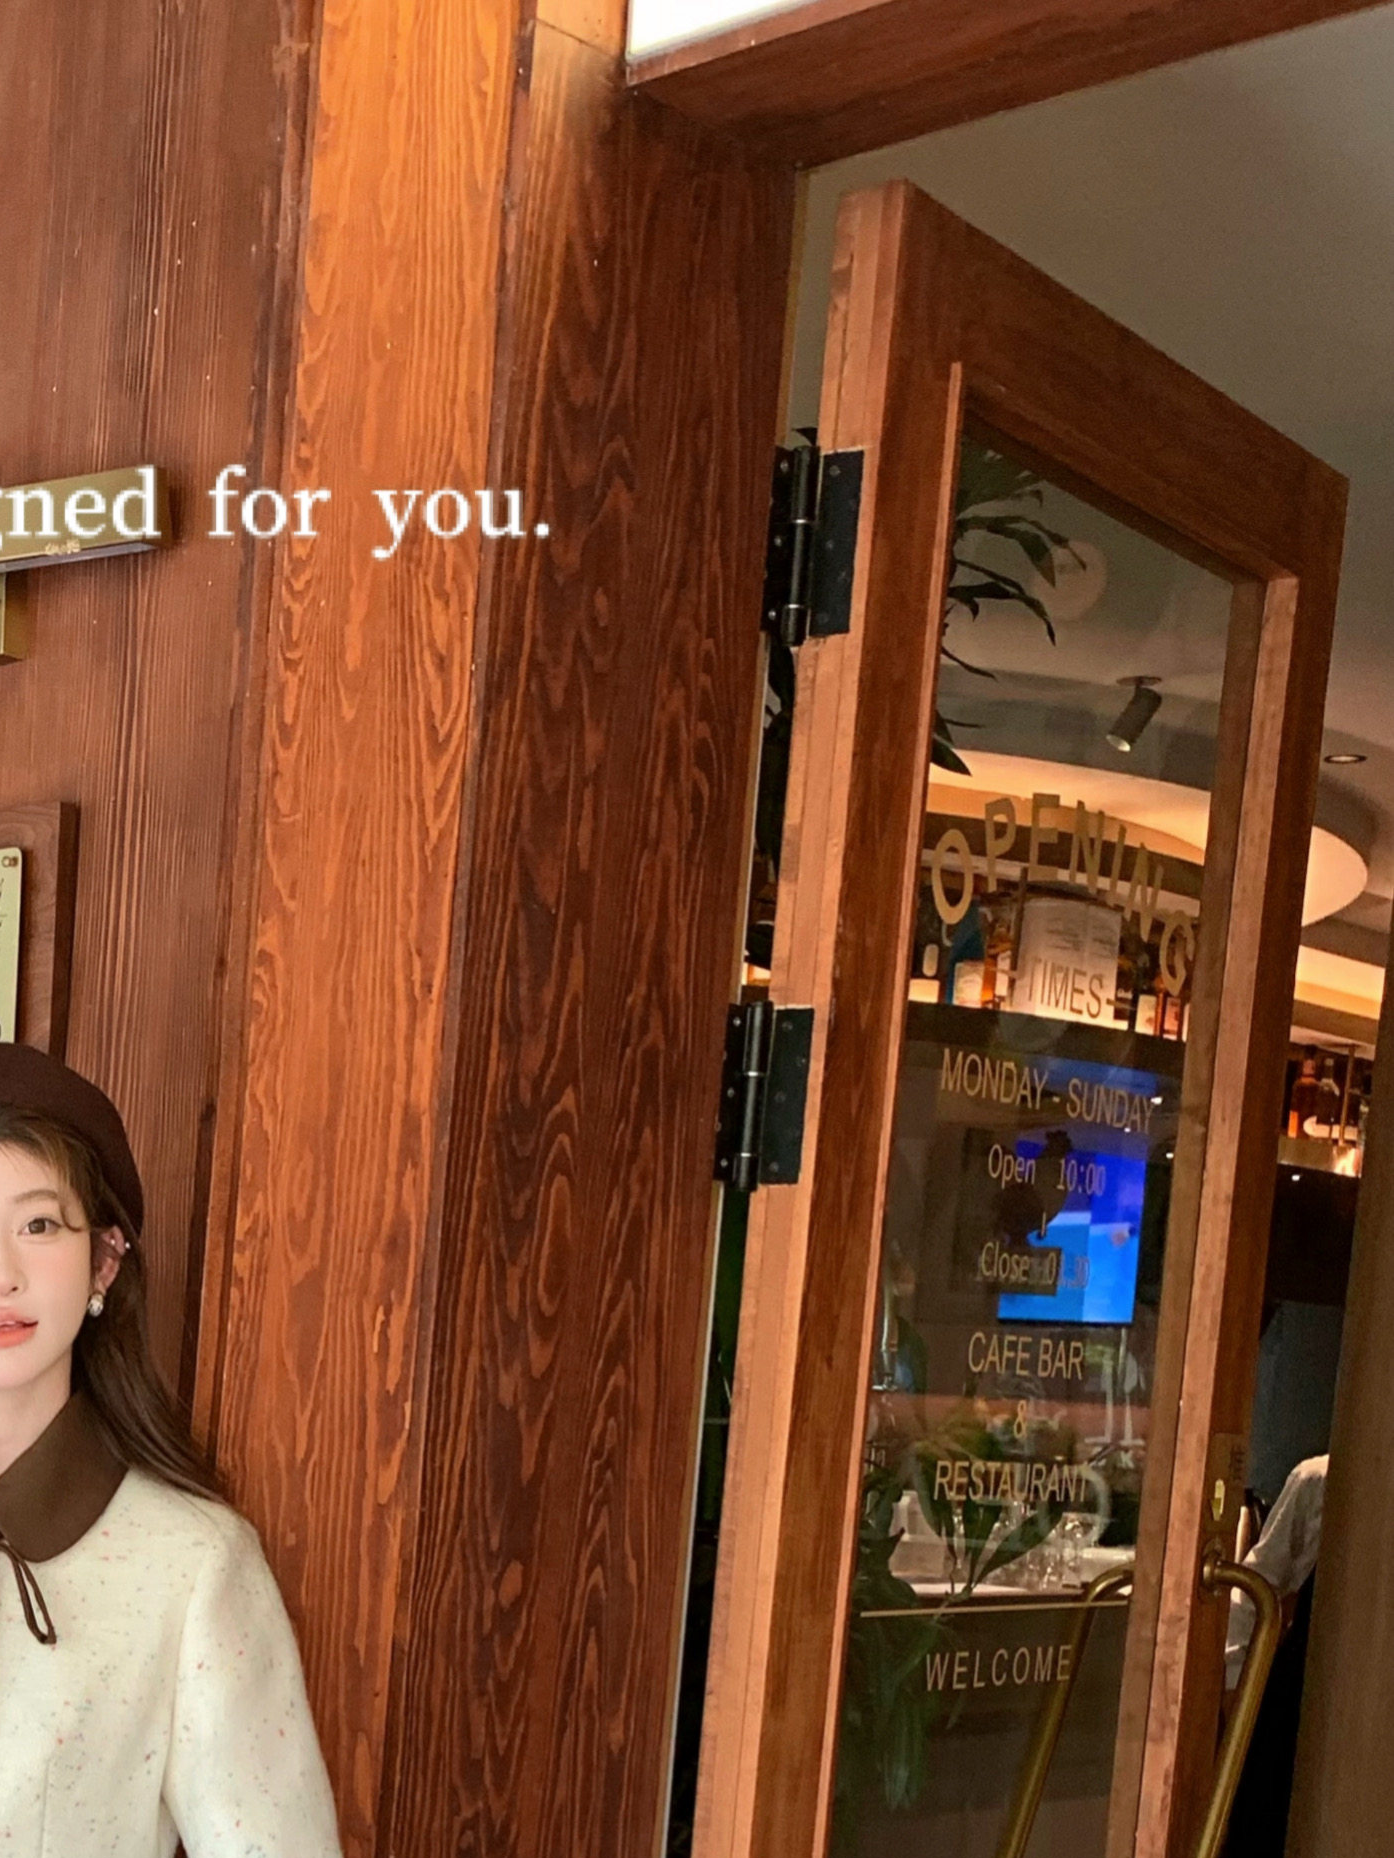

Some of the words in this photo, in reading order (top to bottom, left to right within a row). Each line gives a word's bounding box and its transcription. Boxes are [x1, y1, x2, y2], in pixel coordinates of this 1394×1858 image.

[932, 793, 1195, 995] OPENING
[941, 1048, 1049, 1110] MONDAY
[1067, 1078, 1156, 1135] SUNDAY
[988, 1144, 1036, 1188] Open
[1056, 1158, 1106, 1196] 10:00
[981, 1242, 1030, 1282] Close
[969, 1331, 1032, 1376] CAFE
[1038, 1338, 1084, 1380] BAR
[1014, 1399, 1028, 1439] &
[935, 1460, 1091, 1503] RESTAURANT
[925, 1644, 1074, 1692] WELCOME
